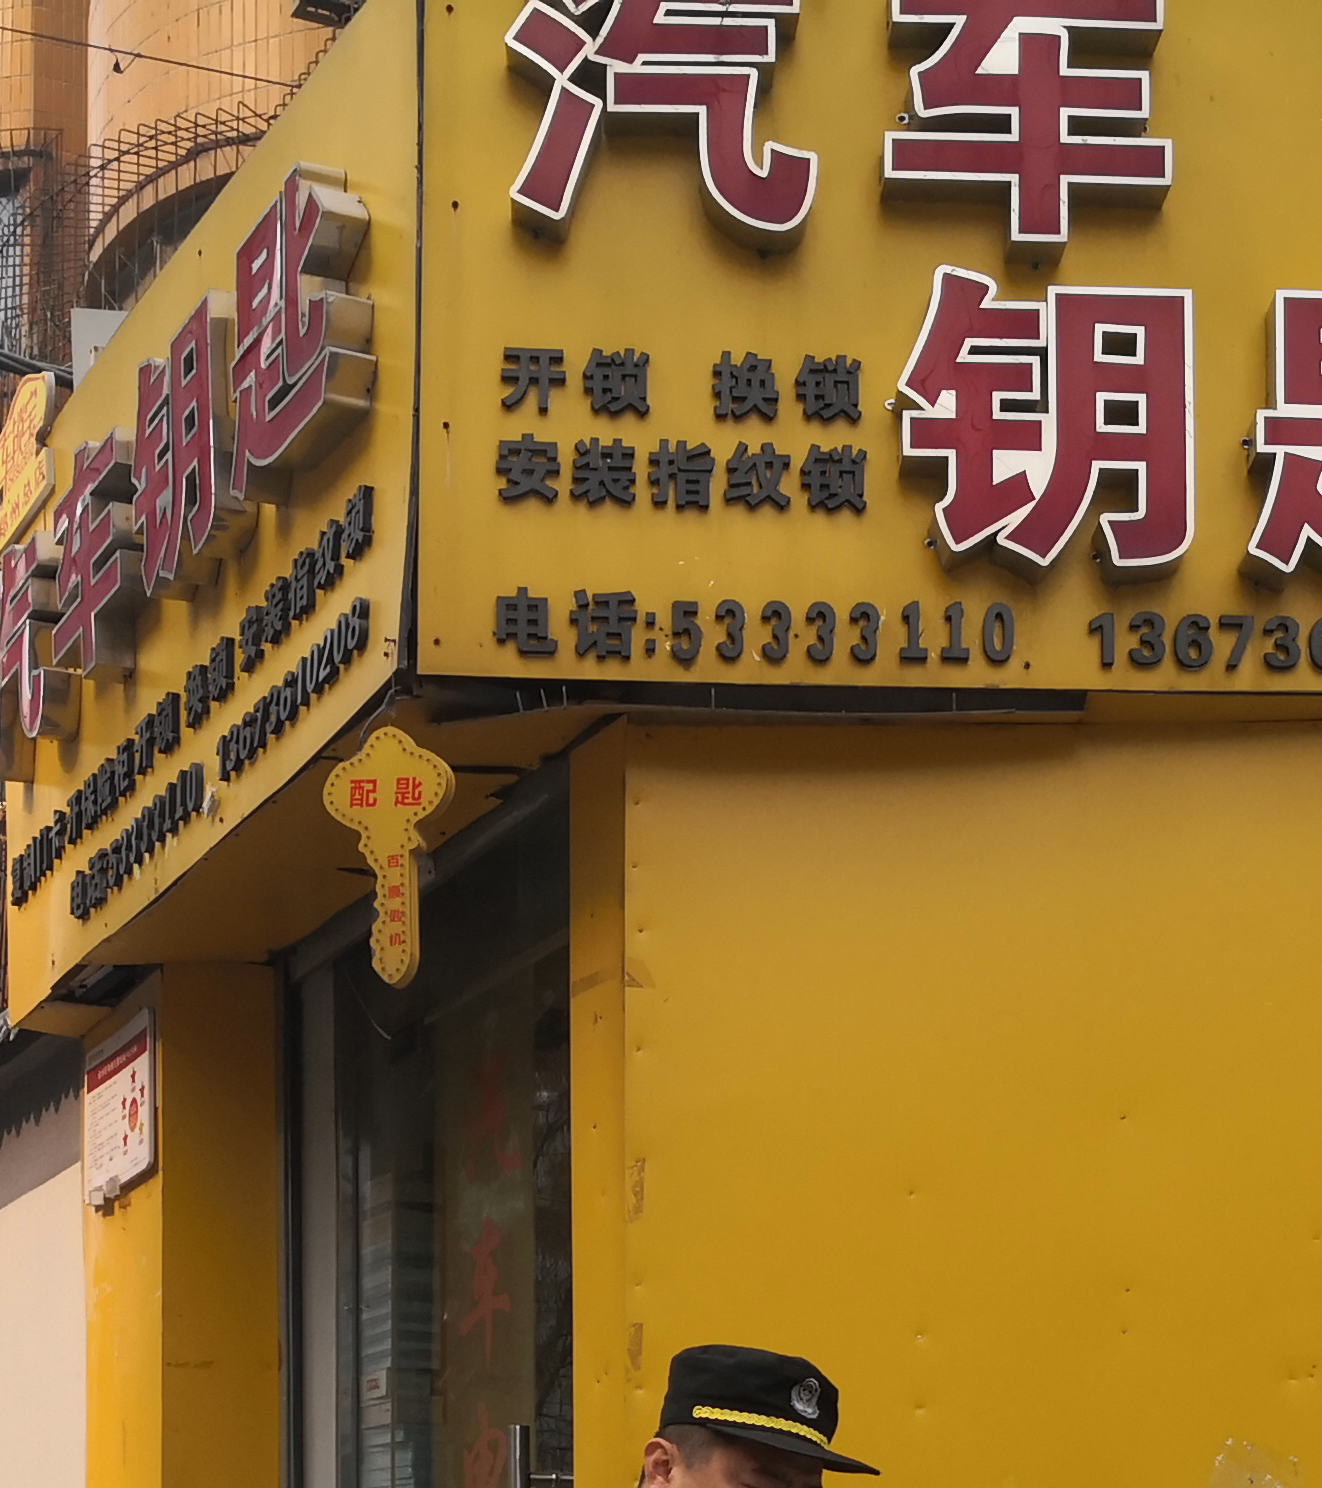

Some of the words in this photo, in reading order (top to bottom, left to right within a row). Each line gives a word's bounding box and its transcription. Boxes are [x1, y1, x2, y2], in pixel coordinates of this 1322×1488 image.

[500, 346, 651, 418] 开锁
[712, 350, 863, 424] 换锁
[495, 432, 869, 514] 安装指纹锁
[215, 597, 369, 780] 13673610208
[349, 777, 423, 809] 配匙
